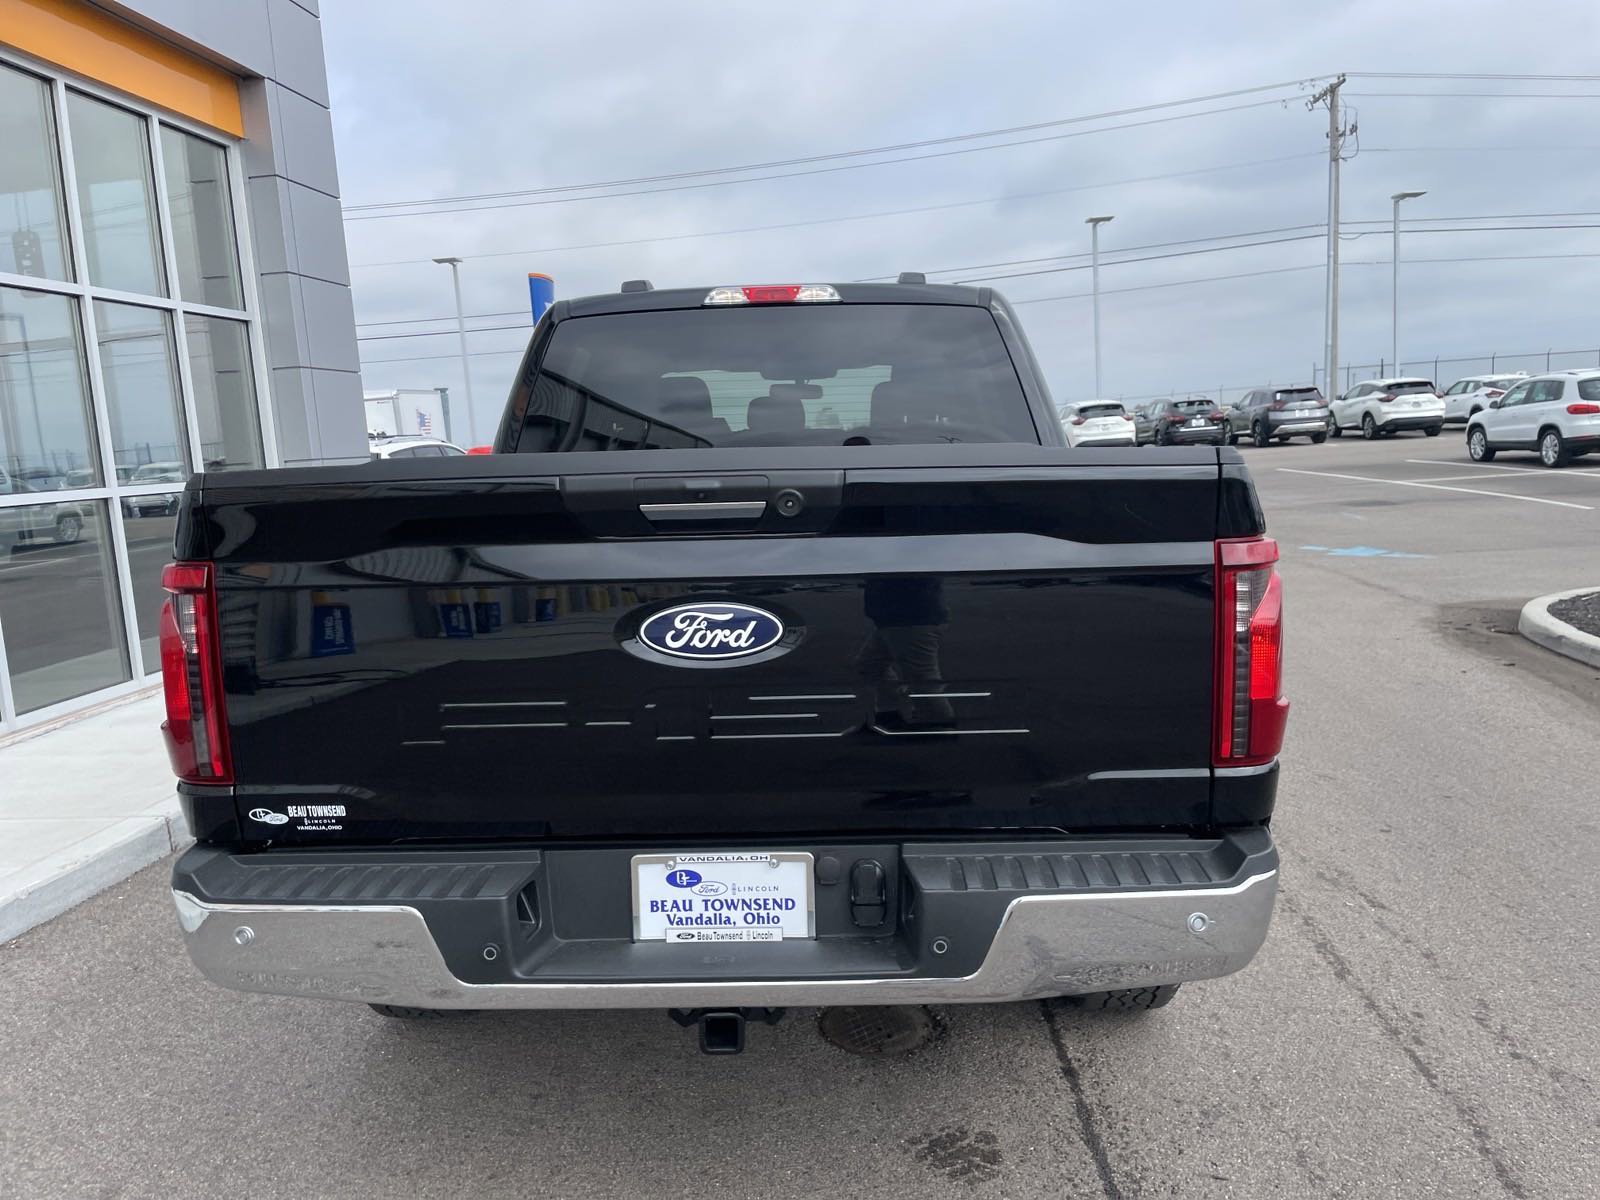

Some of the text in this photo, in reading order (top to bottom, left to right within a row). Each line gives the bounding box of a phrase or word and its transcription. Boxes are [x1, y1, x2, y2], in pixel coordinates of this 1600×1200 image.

[665, 611, 758, 649] Ford
[287, 805, 346, 817] BEAU TOWNSEND
[698, 884, 720, 894] Ford
[650, 898, 796, 912] BEAU TOWNSEND
[666, 913, 780, 926] Vandalia, Ohio
[752, 931, 773, 939] Lincoln
